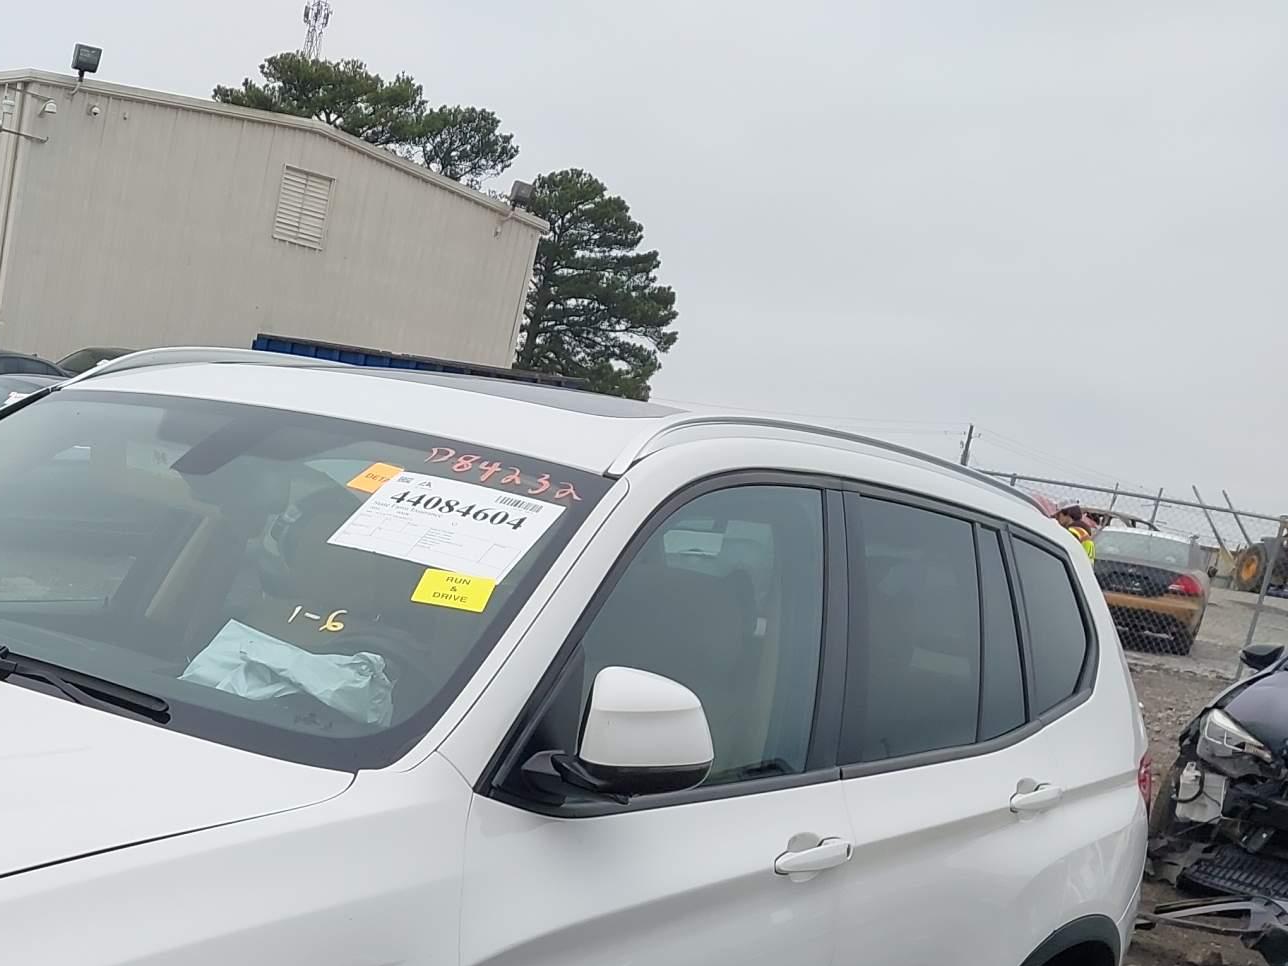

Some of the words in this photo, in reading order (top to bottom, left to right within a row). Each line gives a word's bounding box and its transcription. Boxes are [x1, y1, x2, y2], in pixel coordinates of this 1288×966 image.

[391, 490, 528, 531] 44084604
[445, 576, 472, 586] RUN
[432, 591, 468, 603] DRIVE
